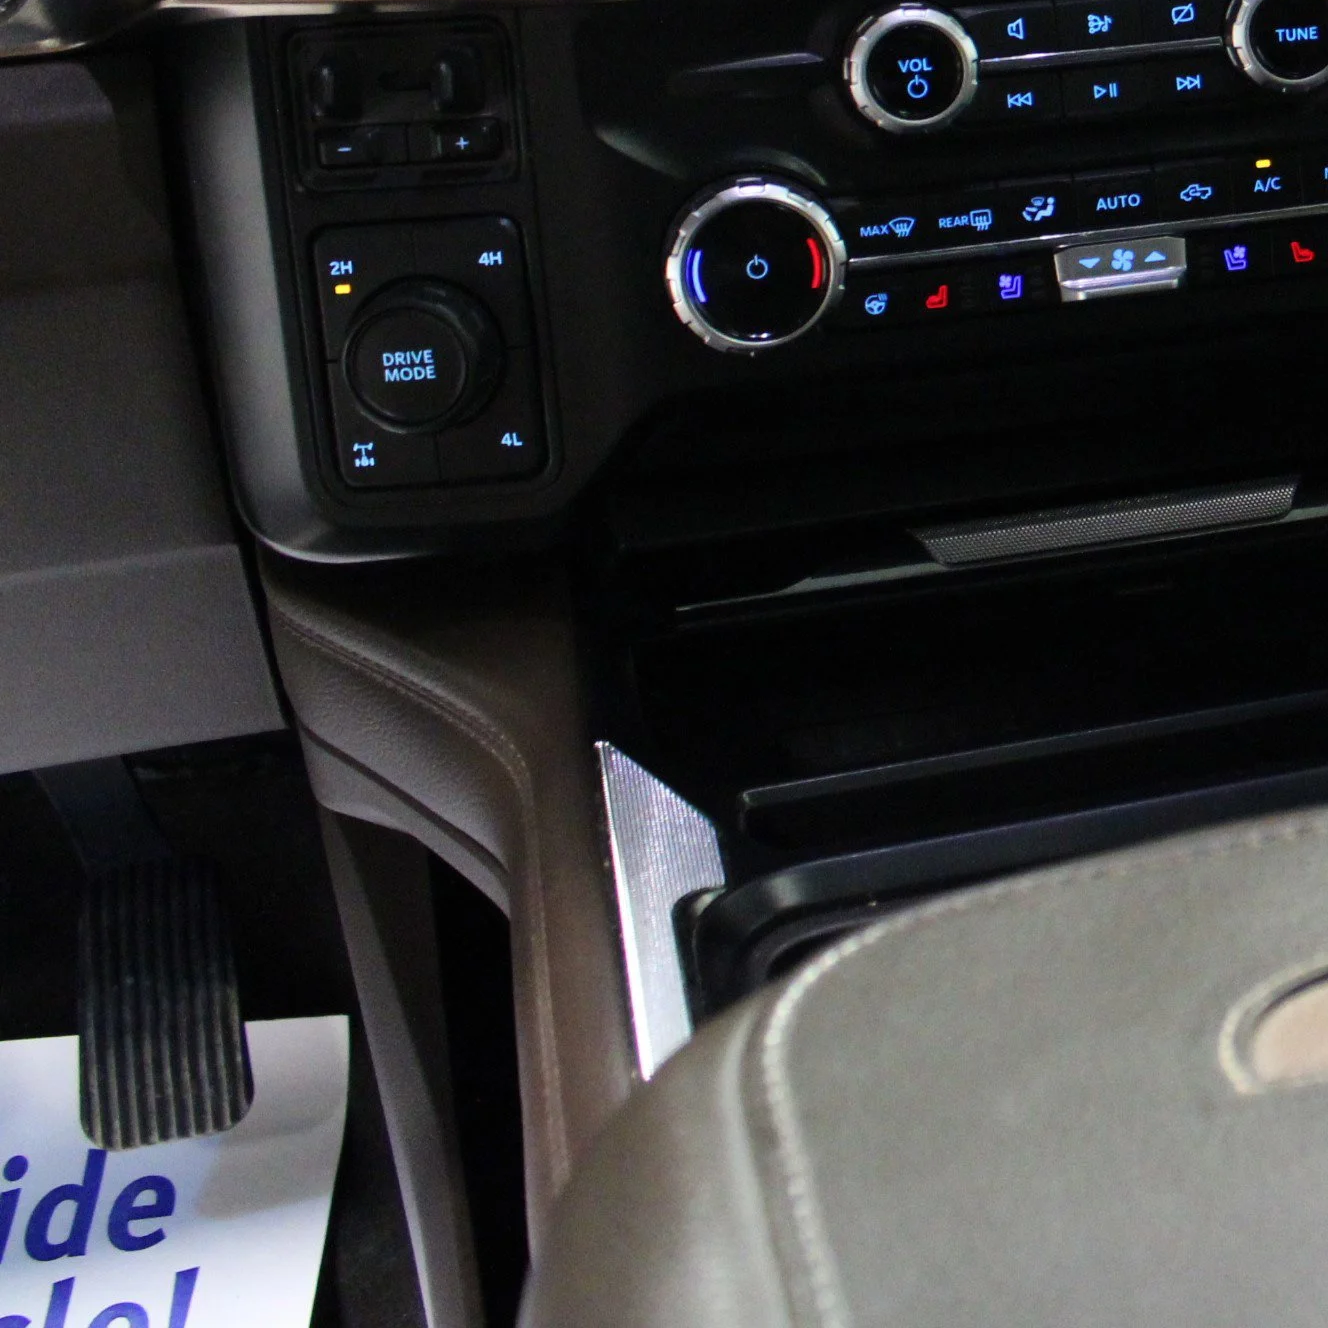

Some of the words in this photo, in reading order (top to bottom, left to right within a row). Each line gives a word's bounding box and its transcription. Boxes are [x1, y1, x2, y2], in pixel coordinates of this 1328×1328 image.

[1275, 25, 1318, 42] TUNE
[897, 57, 933, 73] VOL
[1254, 176, 1282, 193] A/C
[1096, 193, 1141, 211] AUTO
[860, 223, 889, 238] MAX
[938, 214, 970, 230] REAR
[478, 250, 503, 267] 4H
[329, 260, 353, 276] 2H
[382, 349, 435, 367] DRIVE
[384, 366, 436, 383] MODE
[500, 432, 523, 447] 4L
